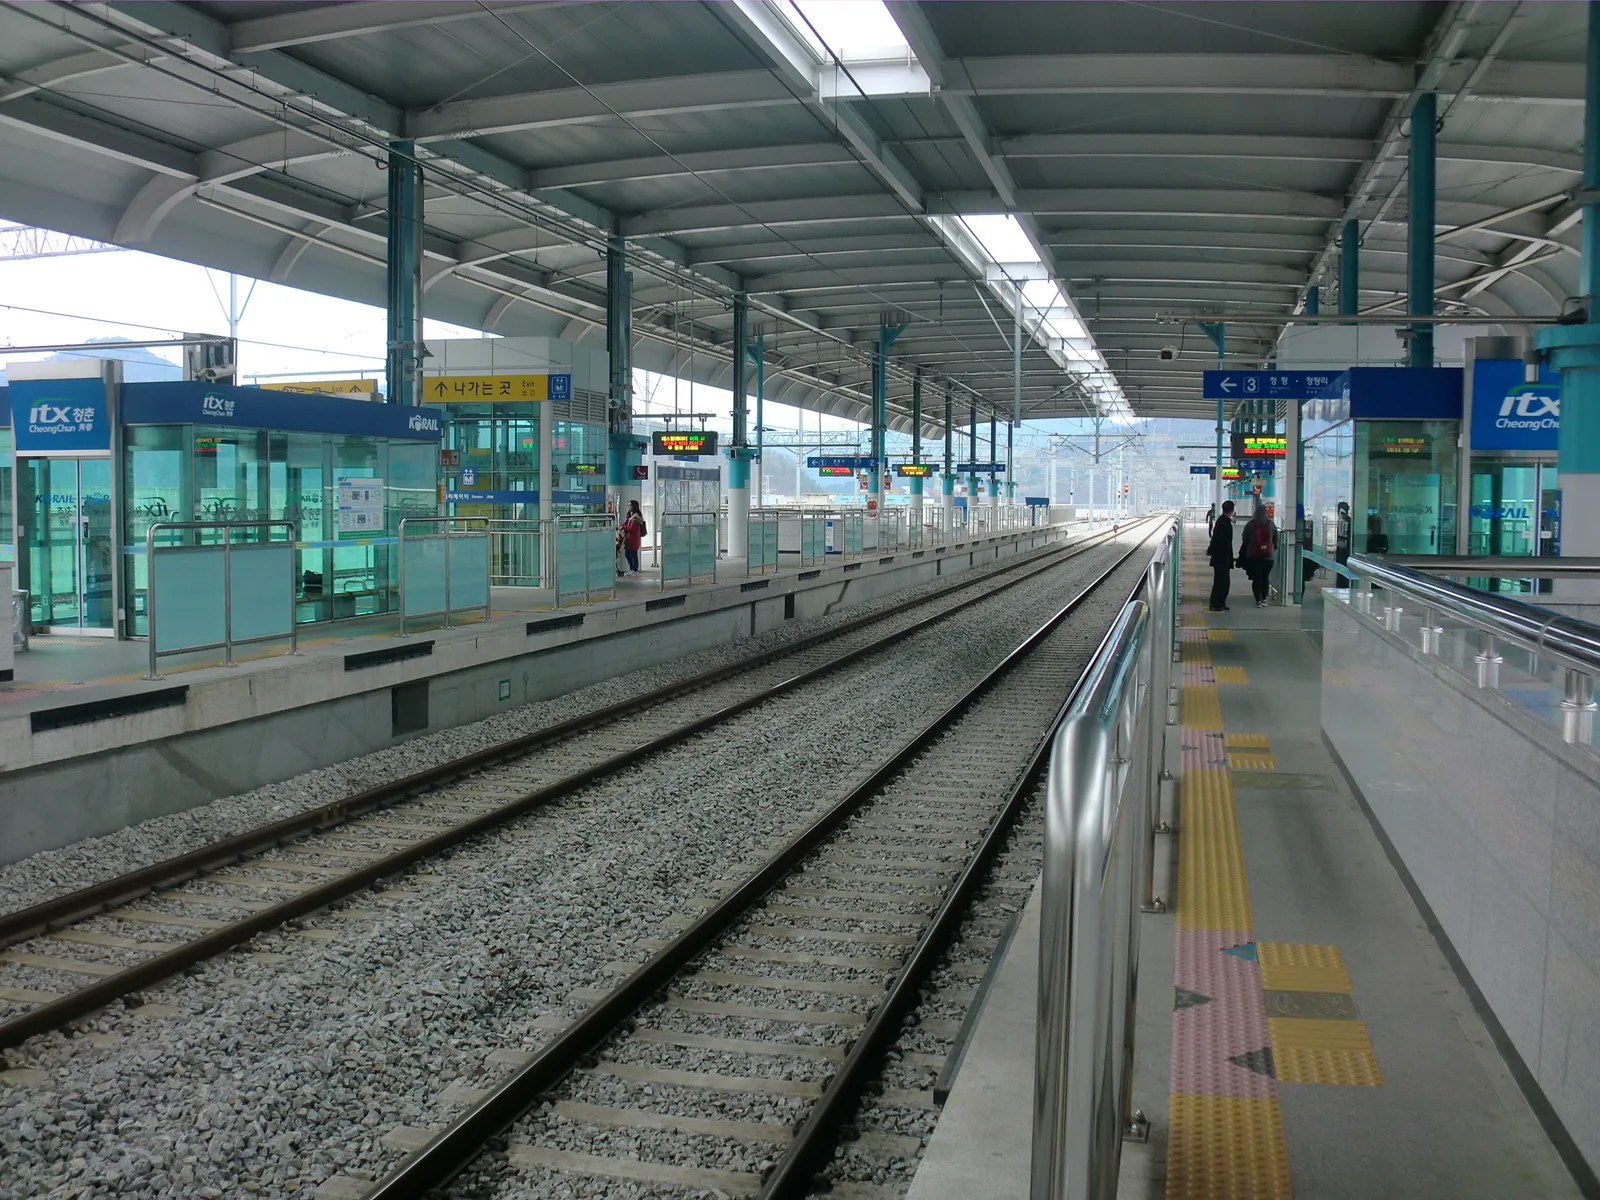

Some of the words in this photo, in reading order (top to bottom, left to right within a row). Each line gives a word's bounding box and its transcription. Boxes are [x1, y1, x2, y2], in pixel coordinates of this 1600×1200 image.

[454, 381, 493, 396] 나가는
[499, 381, 511, 396] 곳
[522, 380, 535, 388] Exit
[1246, 378, 1256, 391] 3
[203, 395, 225, 410] itx
[1498, 392, 1560, 417] itx
[29, 403, 72, 424] itx
[73, 407, 95, 423] 청춘
[29, 424, 76, 435] CheongChun
[408, 414, 439, 431] KORAIL
[35, 493, 75, 505] KORAIL
